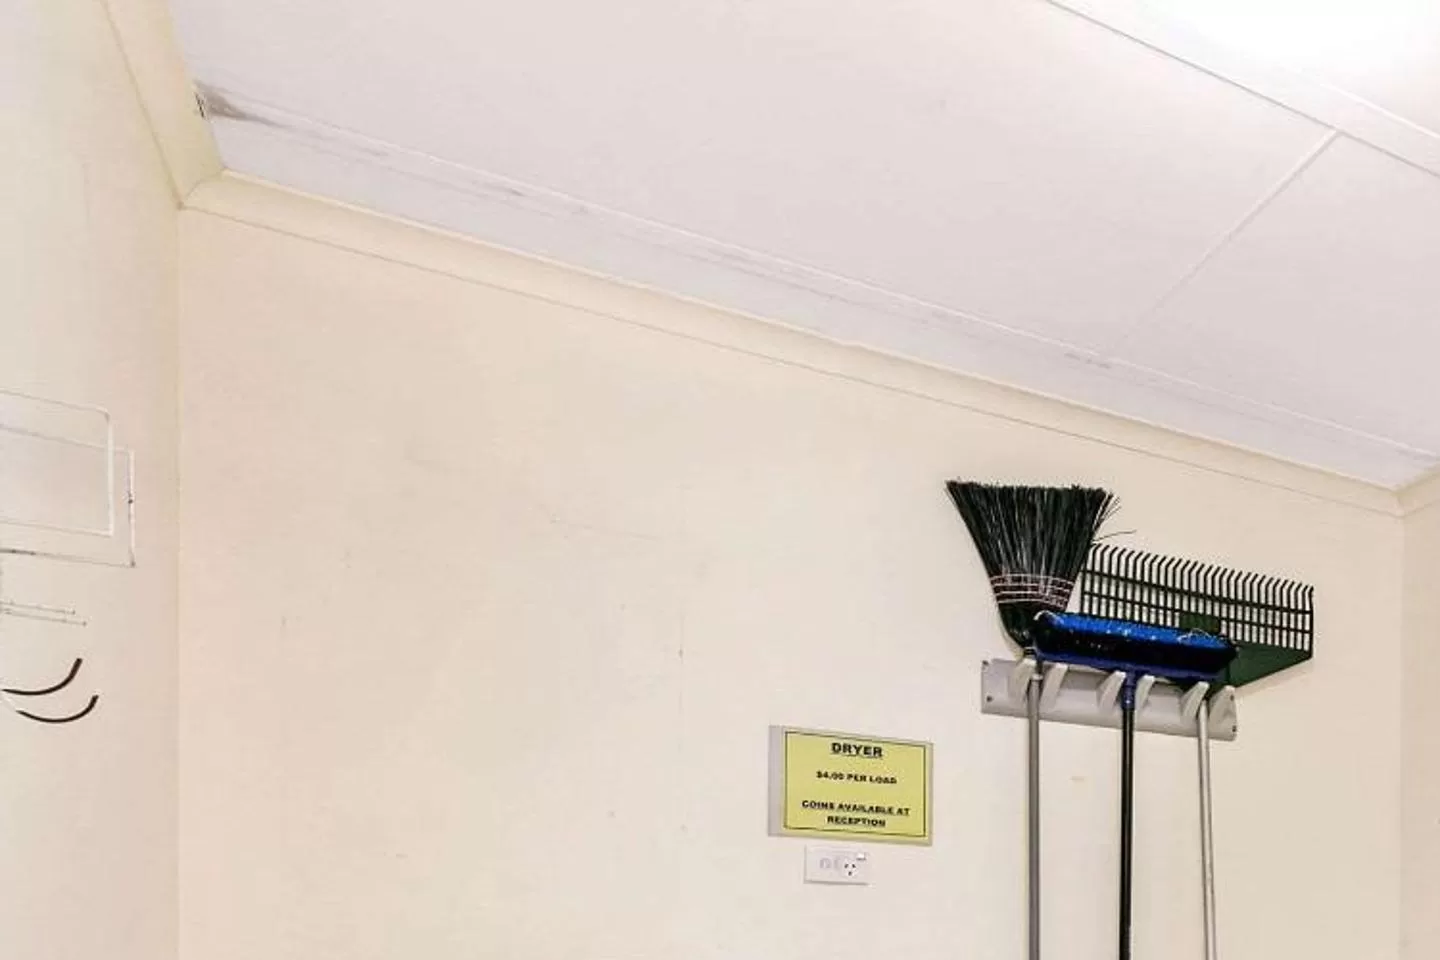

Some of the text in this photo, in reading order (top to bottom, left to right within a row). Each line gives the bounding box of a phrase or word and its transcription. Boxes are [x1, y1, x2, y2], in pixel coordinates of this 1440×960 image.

[831, 742, 883, 758] DRYER
[816, 771, 898, 785] $4.00 PER LOAD
[802, 800, 911, 816] COINS AVAILABLE AT
[827, 815, 886, 828] RECEPTION
